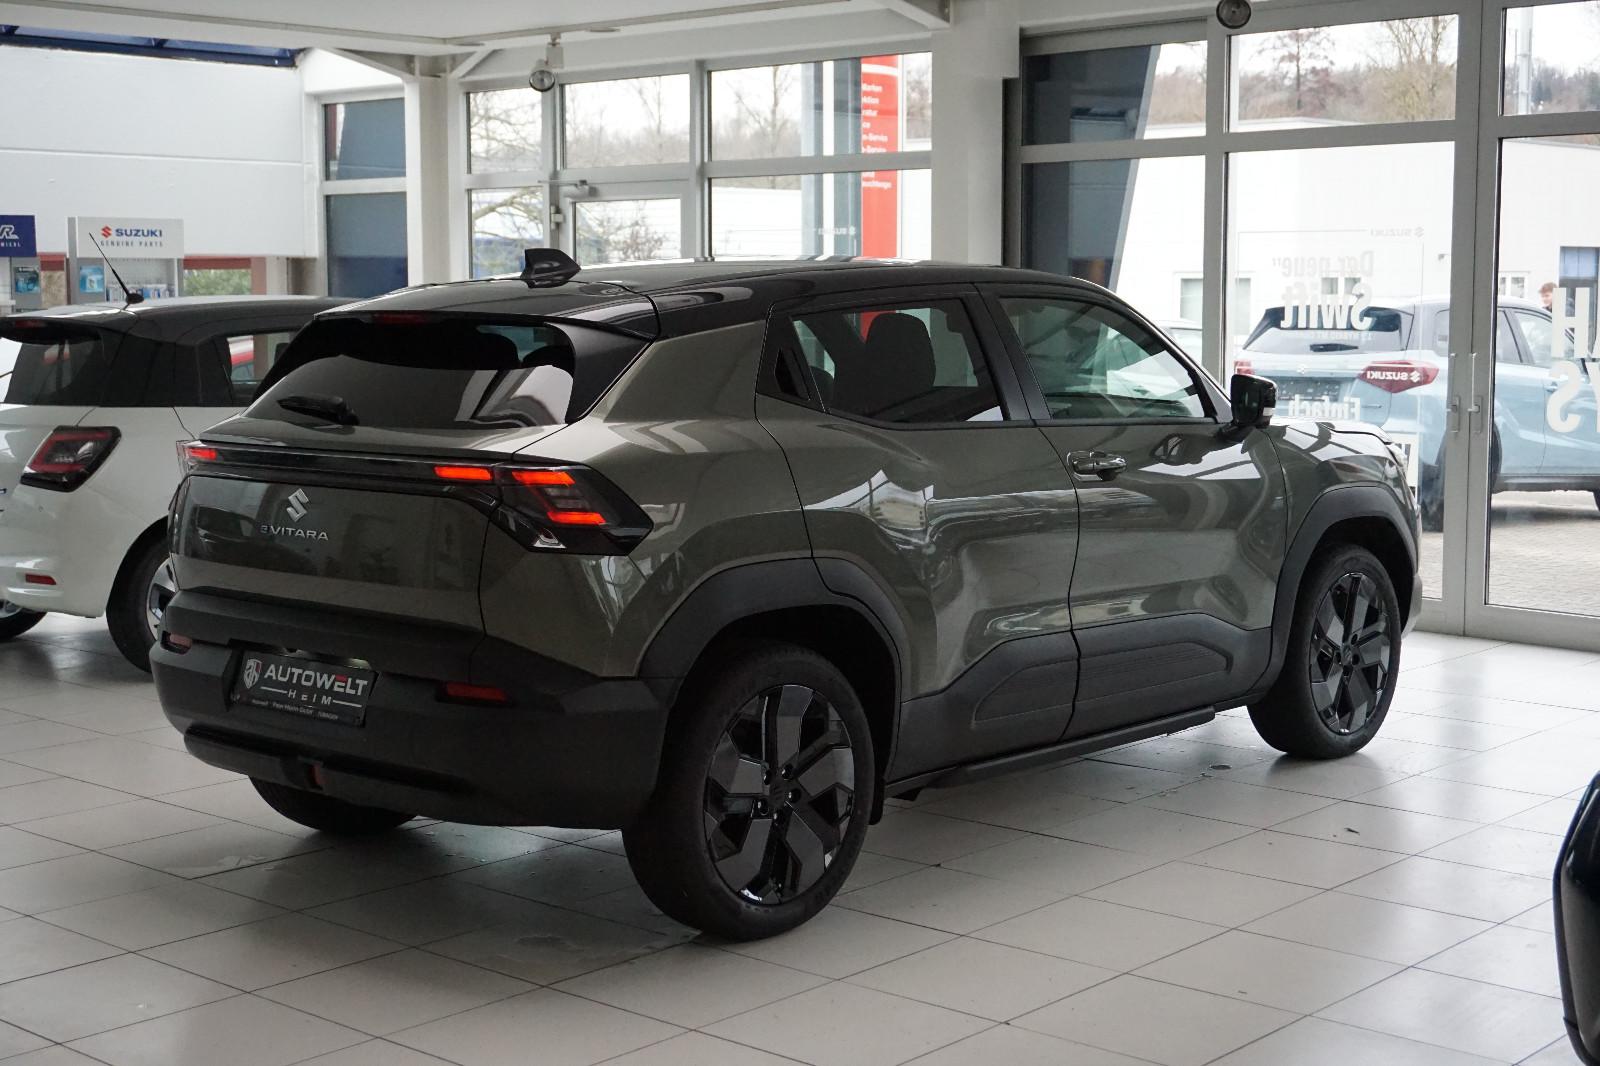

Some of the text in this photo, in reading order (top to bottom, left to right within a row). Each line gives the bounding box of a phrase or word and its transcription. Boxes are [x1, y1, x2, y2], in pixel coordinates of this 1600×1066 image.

[115, 228, 163, 238] SUZUKI
[263, 663, 368, 696] AUTOWELT
[287, 688, 332, 706] HEIM
